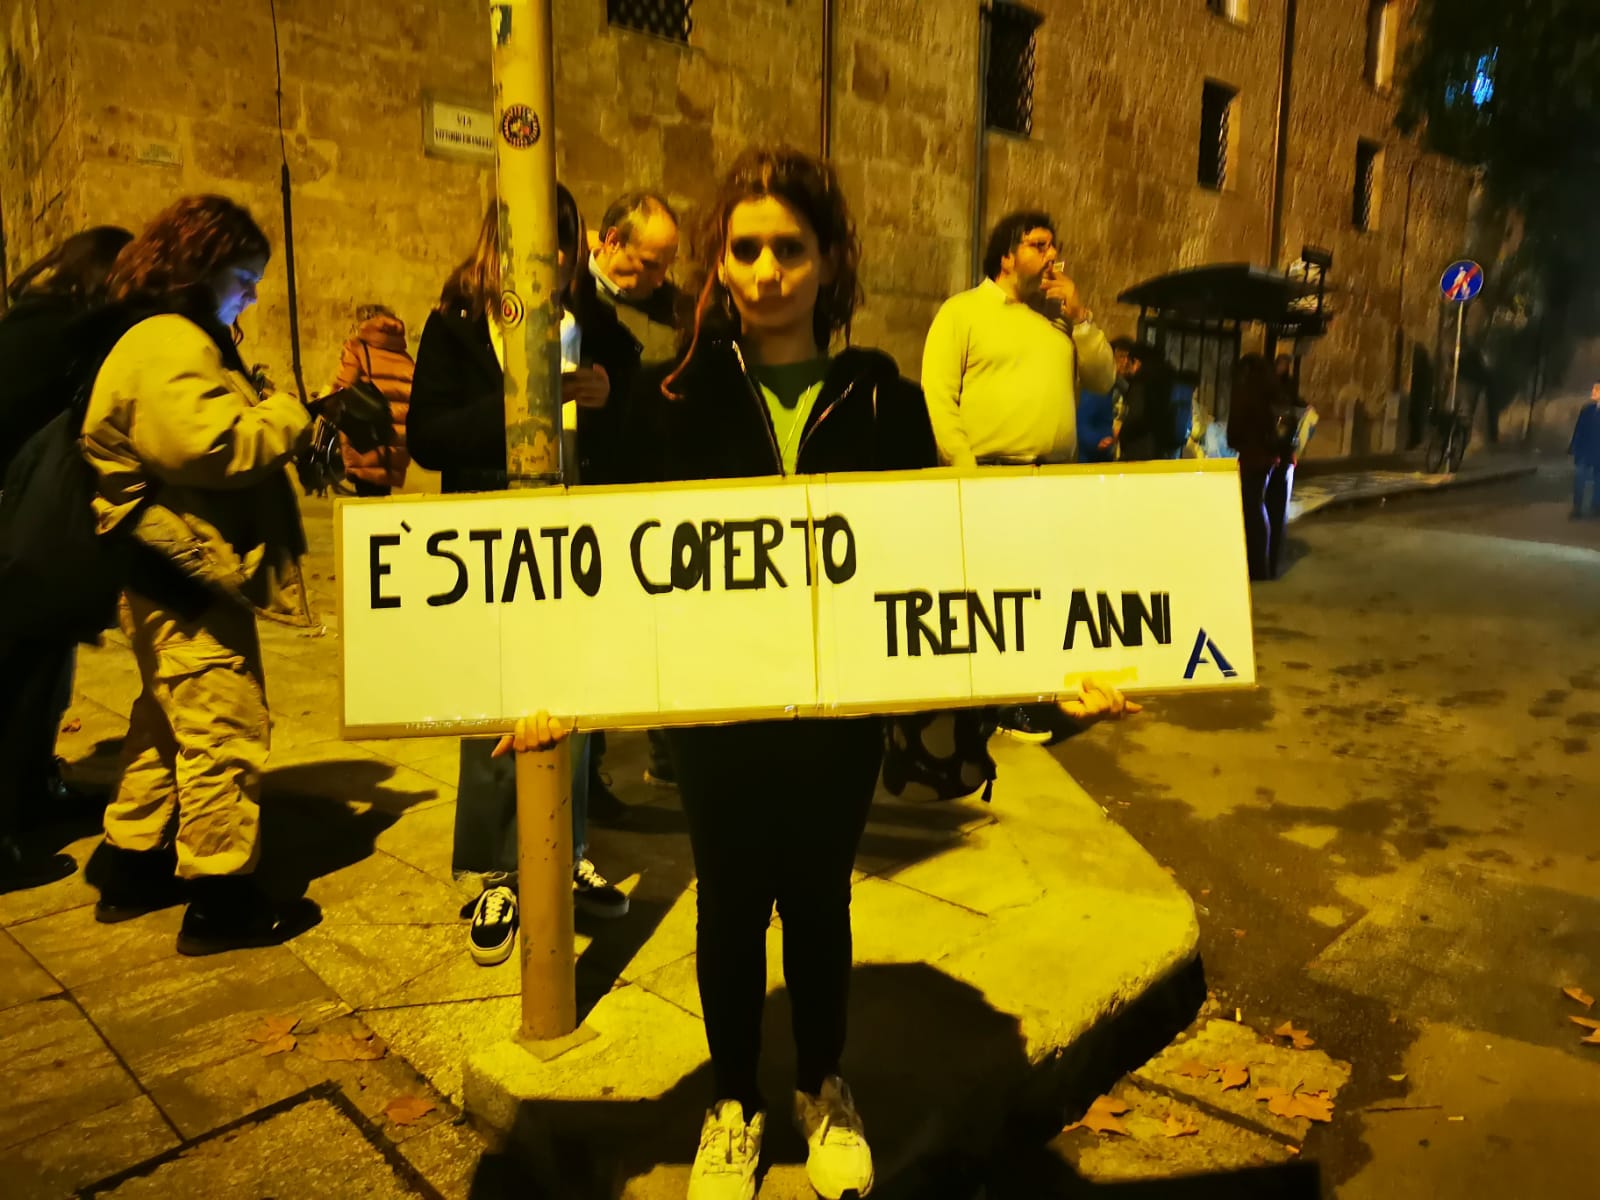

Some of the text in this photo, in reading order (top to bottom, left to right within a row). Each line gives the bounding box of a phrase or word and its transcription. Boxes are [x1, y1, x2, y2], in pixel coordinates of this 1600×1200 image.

[457, 112, 472, 128] VIA
[427, 526, 602, 607] STATO
[630, 514, 857, 594] COPERTO
[1063, 588, 1171, 650] ANNI
